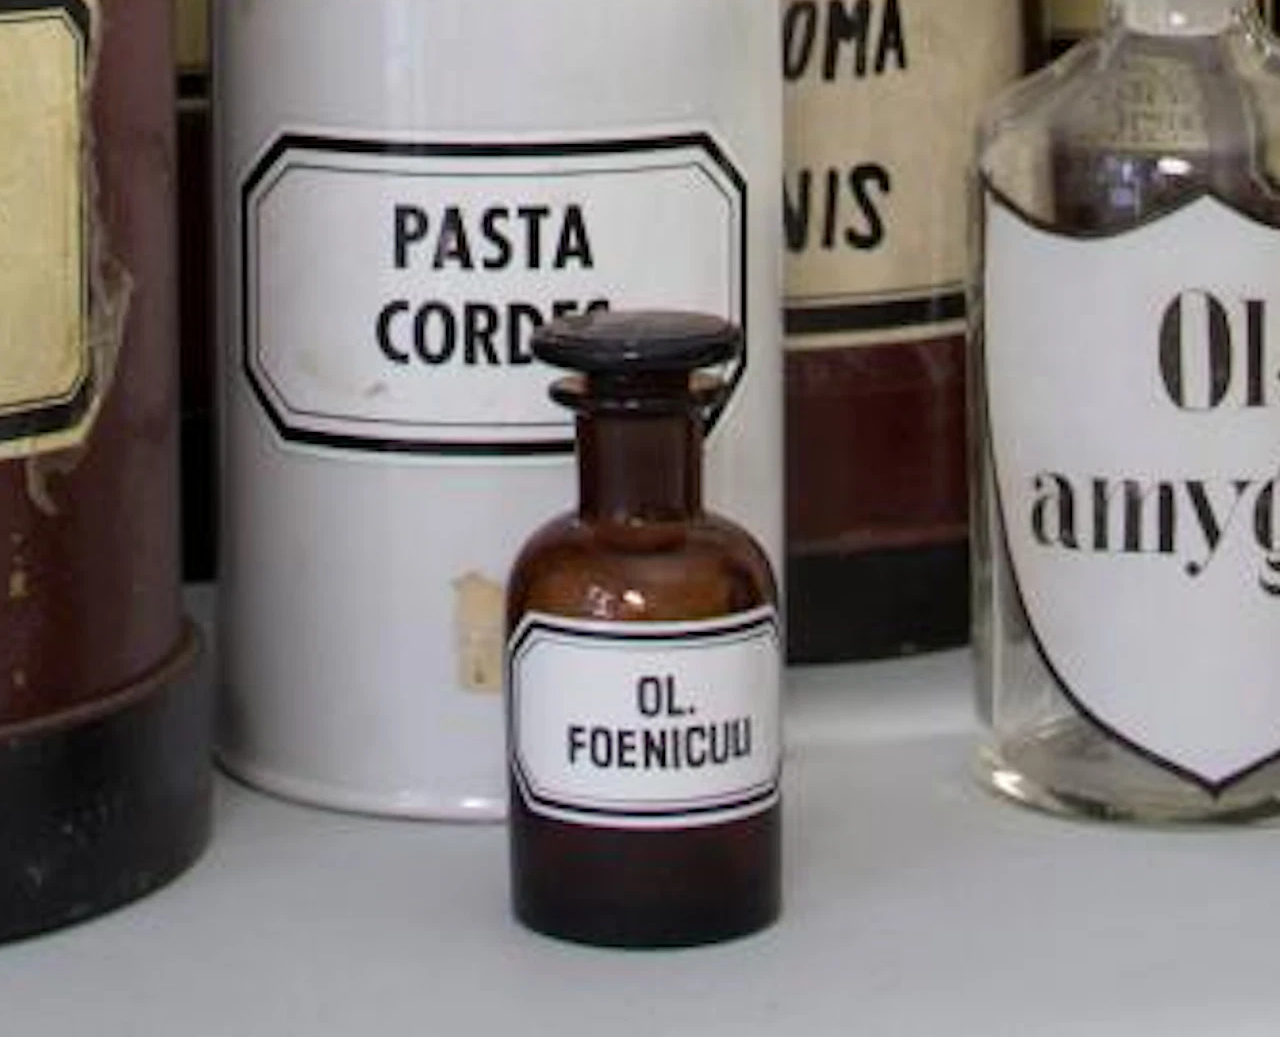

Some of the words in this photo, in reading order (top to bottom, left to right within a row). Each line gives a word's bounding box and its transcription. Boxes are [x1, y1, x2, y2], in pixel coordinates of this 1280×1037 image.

[393, 203, 594, 269] PASTA
[376, 300, 610, 365] CORD
[637, 674, 696, 717] OL.
